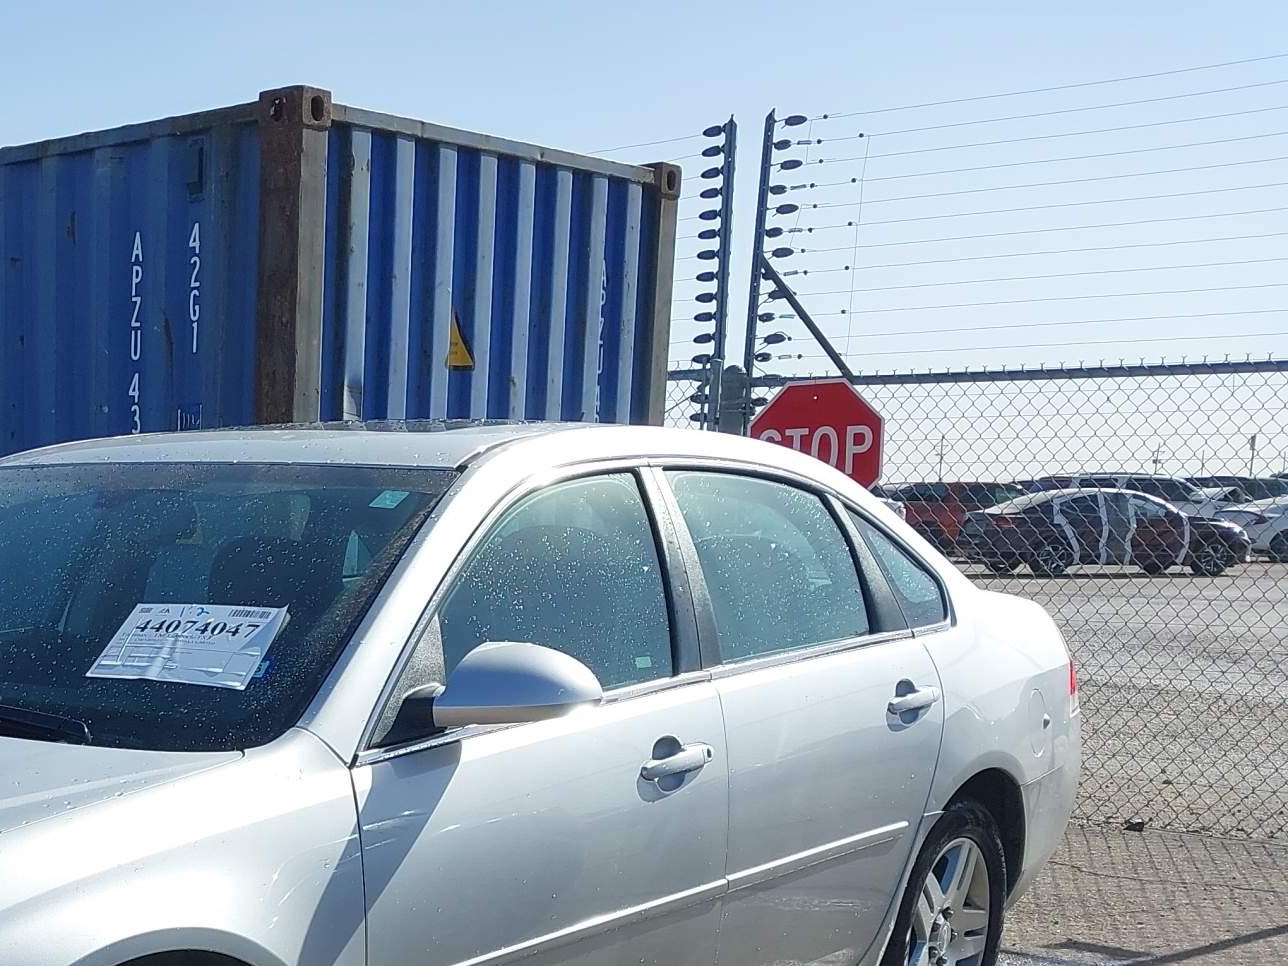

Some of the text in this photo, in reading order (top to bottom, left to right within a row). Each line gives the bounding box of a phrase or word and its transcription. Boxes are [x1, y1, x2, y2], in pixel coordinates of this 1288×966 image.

[131, 231, 143, 361] APZU
[189, 222, 200, 353] 42G1
[760, 426, 873, 474] TOP
[135, 619, 260, 639] 44074047
